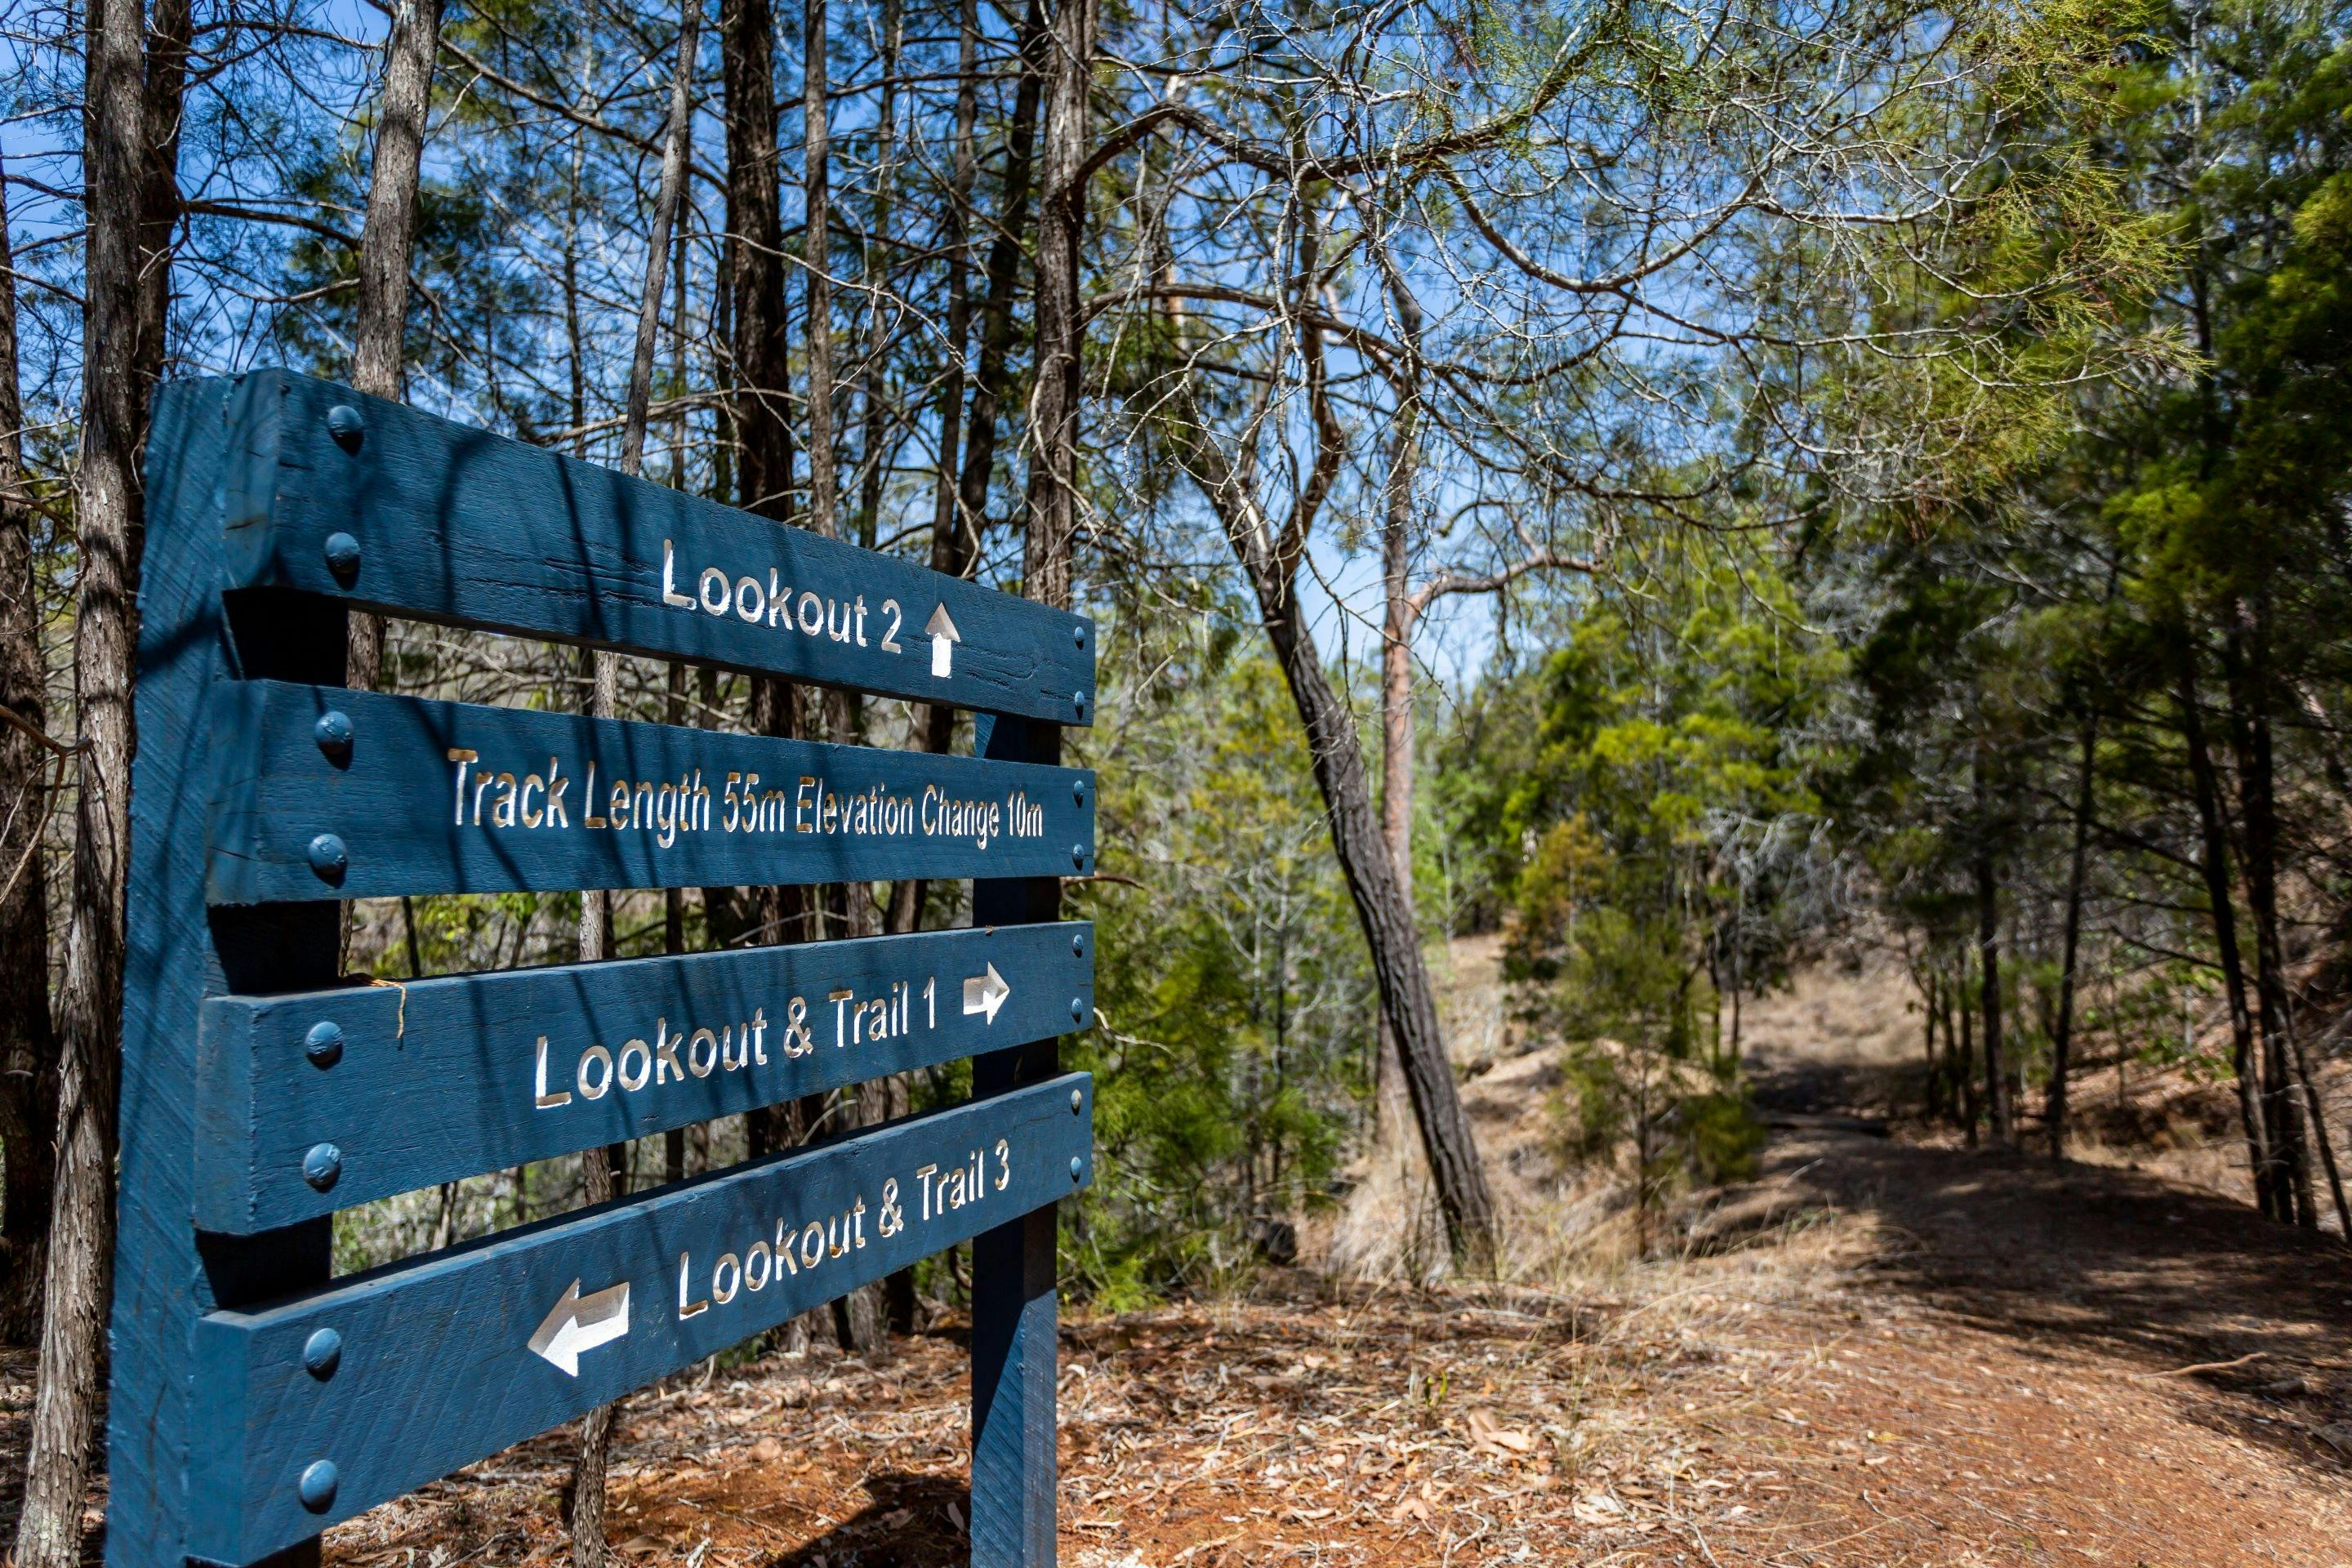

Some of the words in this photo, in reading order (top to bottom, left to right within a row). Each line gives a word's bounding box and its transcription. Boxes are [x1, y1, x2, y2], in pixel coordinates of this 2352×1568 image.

[662, 538, 868, 648] Lookout
[881, 598, 902, 654] 2
[448, 747, 569, 829] Track
[584, 760, 710, 849] Length
[723, 772, 785, 833] 55m
[796, 776, 914, 836] Elevation
[921, 784, 1000, 850] Change
[1007, 791, 1043, 838] 10m
[535, 1007, 768, 1110] Lookout
[783, 996, 814, 1058] &
[828, 981, 909, 1048] Trail
[923, 976, 936, 1029] 1
[679, 1192, 866, 1321] Lookout
[878, 1177, 905, 1238] &
[915, 1150, 985, 1221] Trail
[995, 1138, 1010, 1192] 3
